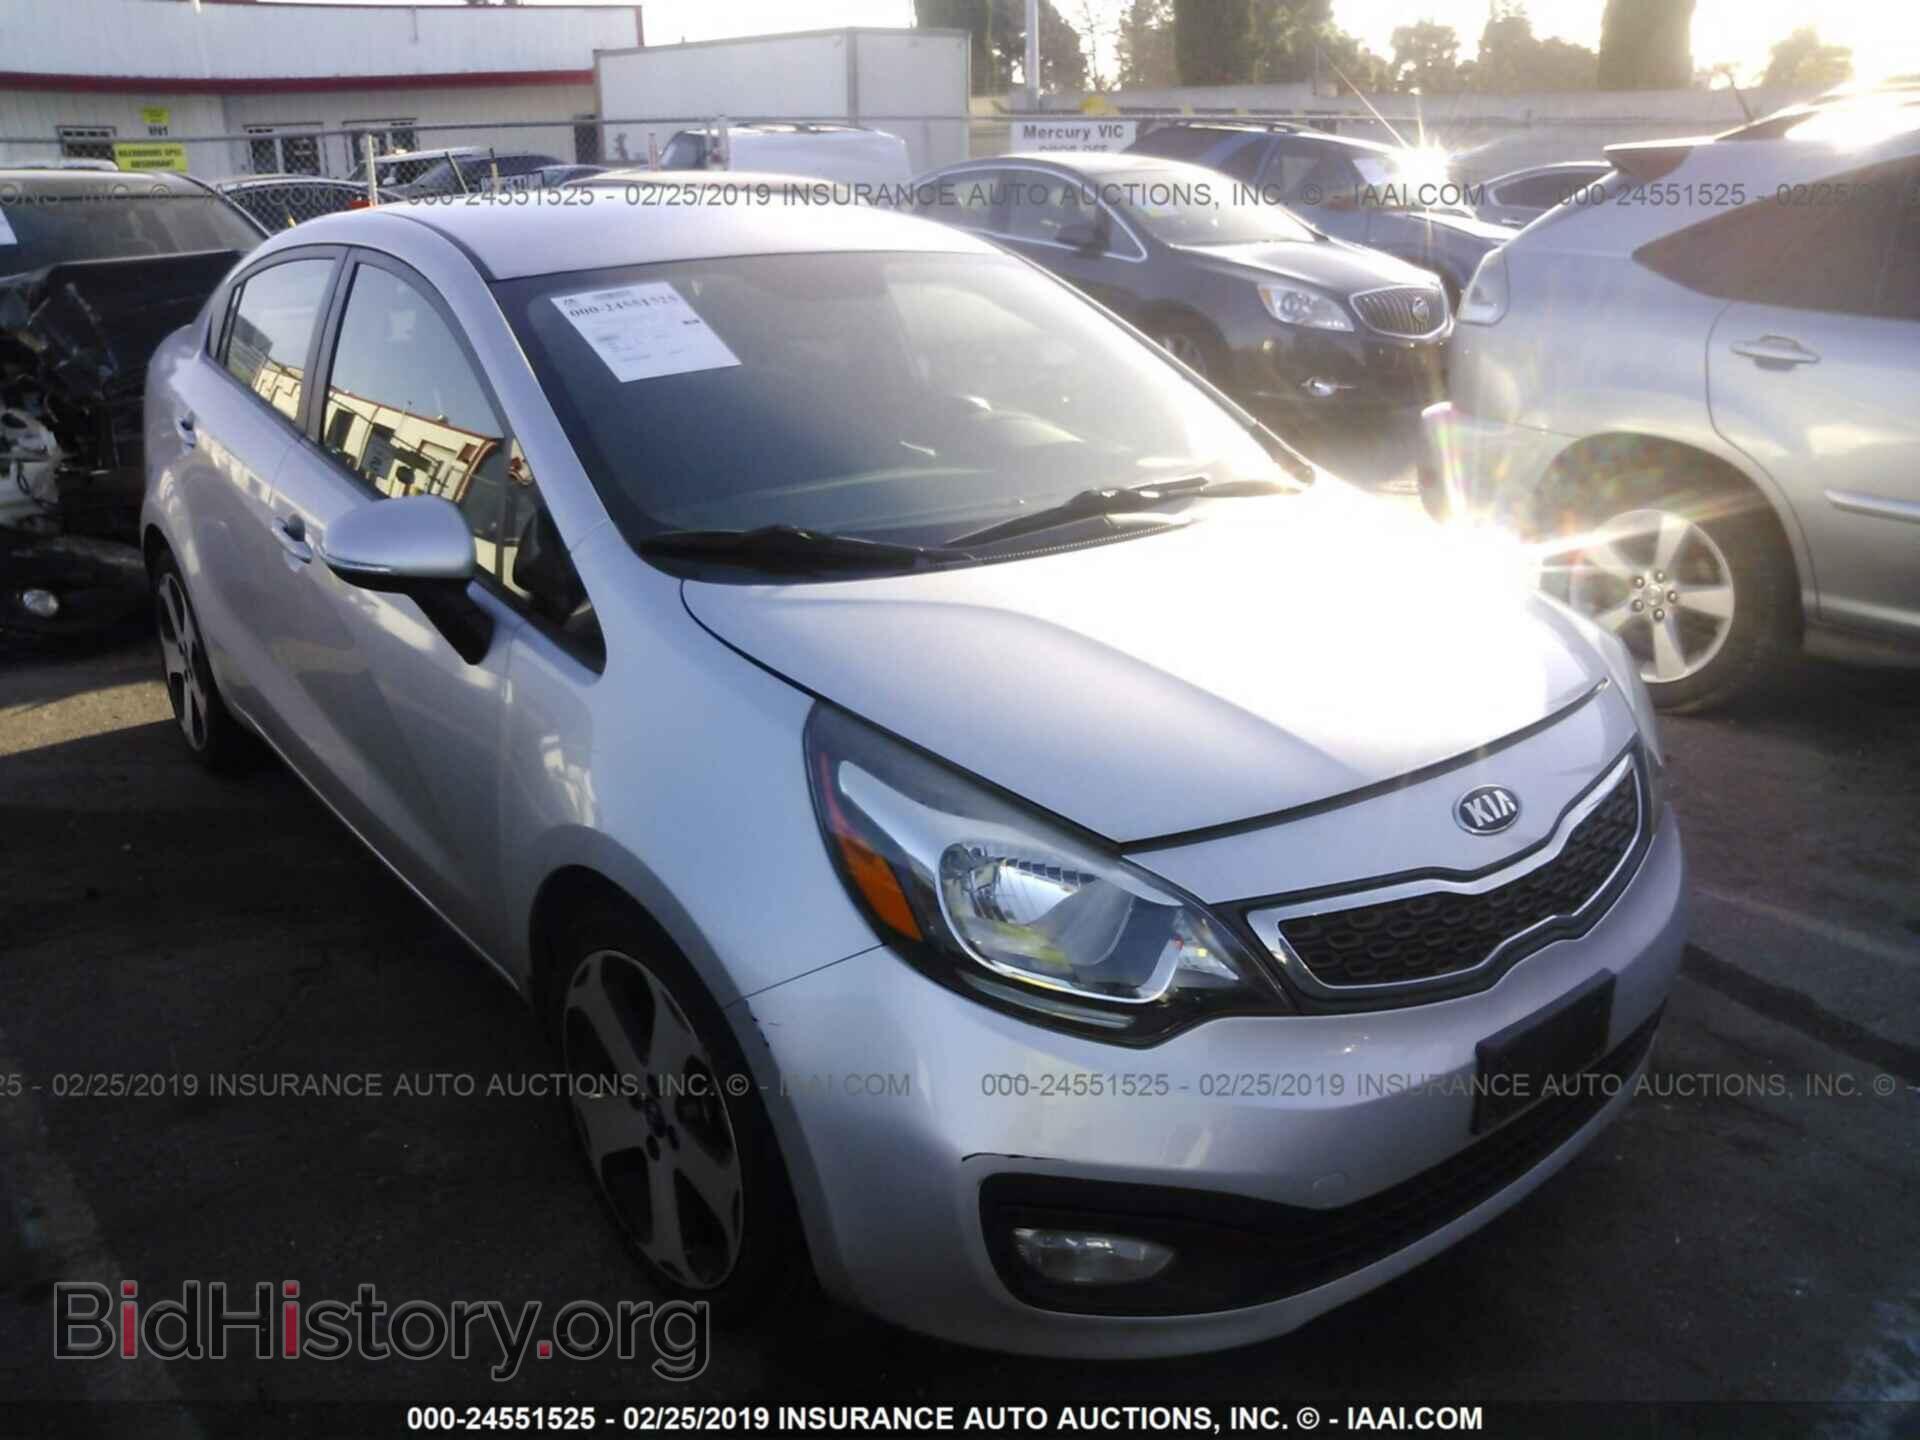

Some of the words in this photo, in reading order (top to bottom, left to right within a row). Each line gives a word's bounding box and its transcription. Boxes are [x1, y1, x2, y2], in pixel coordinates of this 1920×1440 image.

[1023, 125, 1090, 140] Mercury
[1098, 124, 1124, 138] VIC
[1463, 789, 1517, 827] KIA
